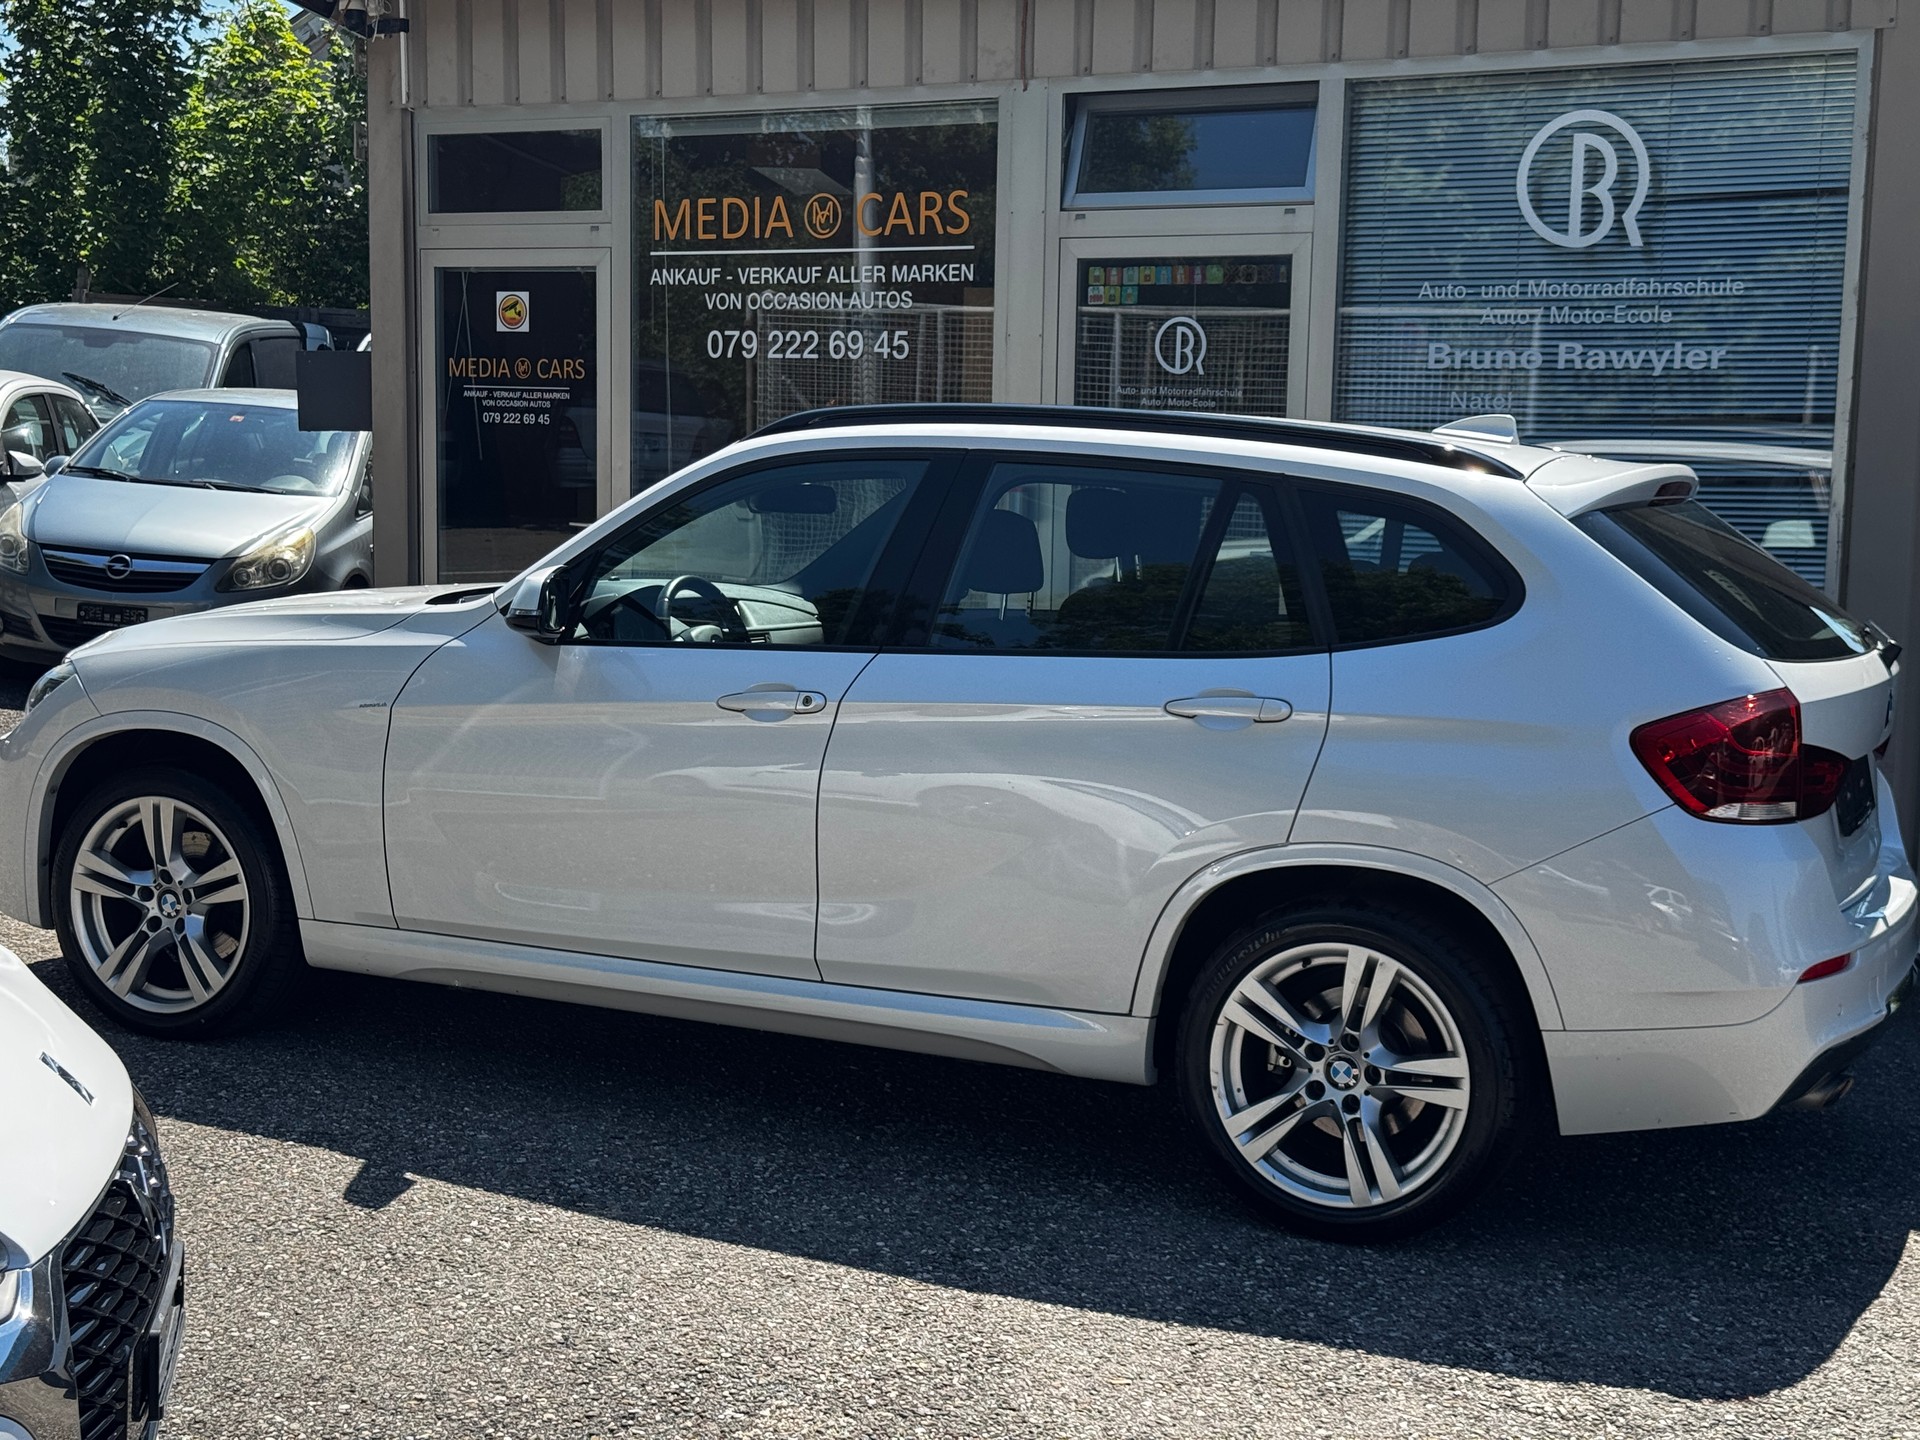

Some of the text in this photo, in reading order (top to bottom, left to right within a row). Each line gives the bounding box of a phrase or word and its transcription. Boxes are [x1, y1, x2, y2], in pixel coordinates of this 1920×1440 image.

[654, 196, 793, 241] MEDIA
[856, 190, 970, 237] CARS
[650, 267, 722, 285] ANKAUF
[738, 266, 822, 285] VERKAUF
[827, 265, 886, 284] ALLER
[891, 263, 975, 283] MARKEN
[1418, 277, 1745, 299] Auto- und Motorradfahrschule
[705, 290, 913, 310] VON OCCASION AUTOS
[1480, 306, 1530, 325] Auto
[1549, 305, 1673, 324] Moto-Ecole
[707, 330, 910, 360] 079 222 69 45
[448, 357, 511, 378] MEDIA
[536, 358, 586, 379] CARS
[1427, 341, 1727, 376] Bruno Rawyler
[463, 390, 488, 398] ANKAUF
[493, 391, 521, 399] VERKAUF
[522, 391, 542, 399] ALLER
[543, 392, 570, 400] MARKEN
[1141, 386, 1157, 395] und
[1159, 386, 1243, 397] Motorradfahrschule
[482, 399, 495, 407] VON
[529, 400, 551, 408] AUTOS
[482, 412, 550, 425] 079 222 69 45
